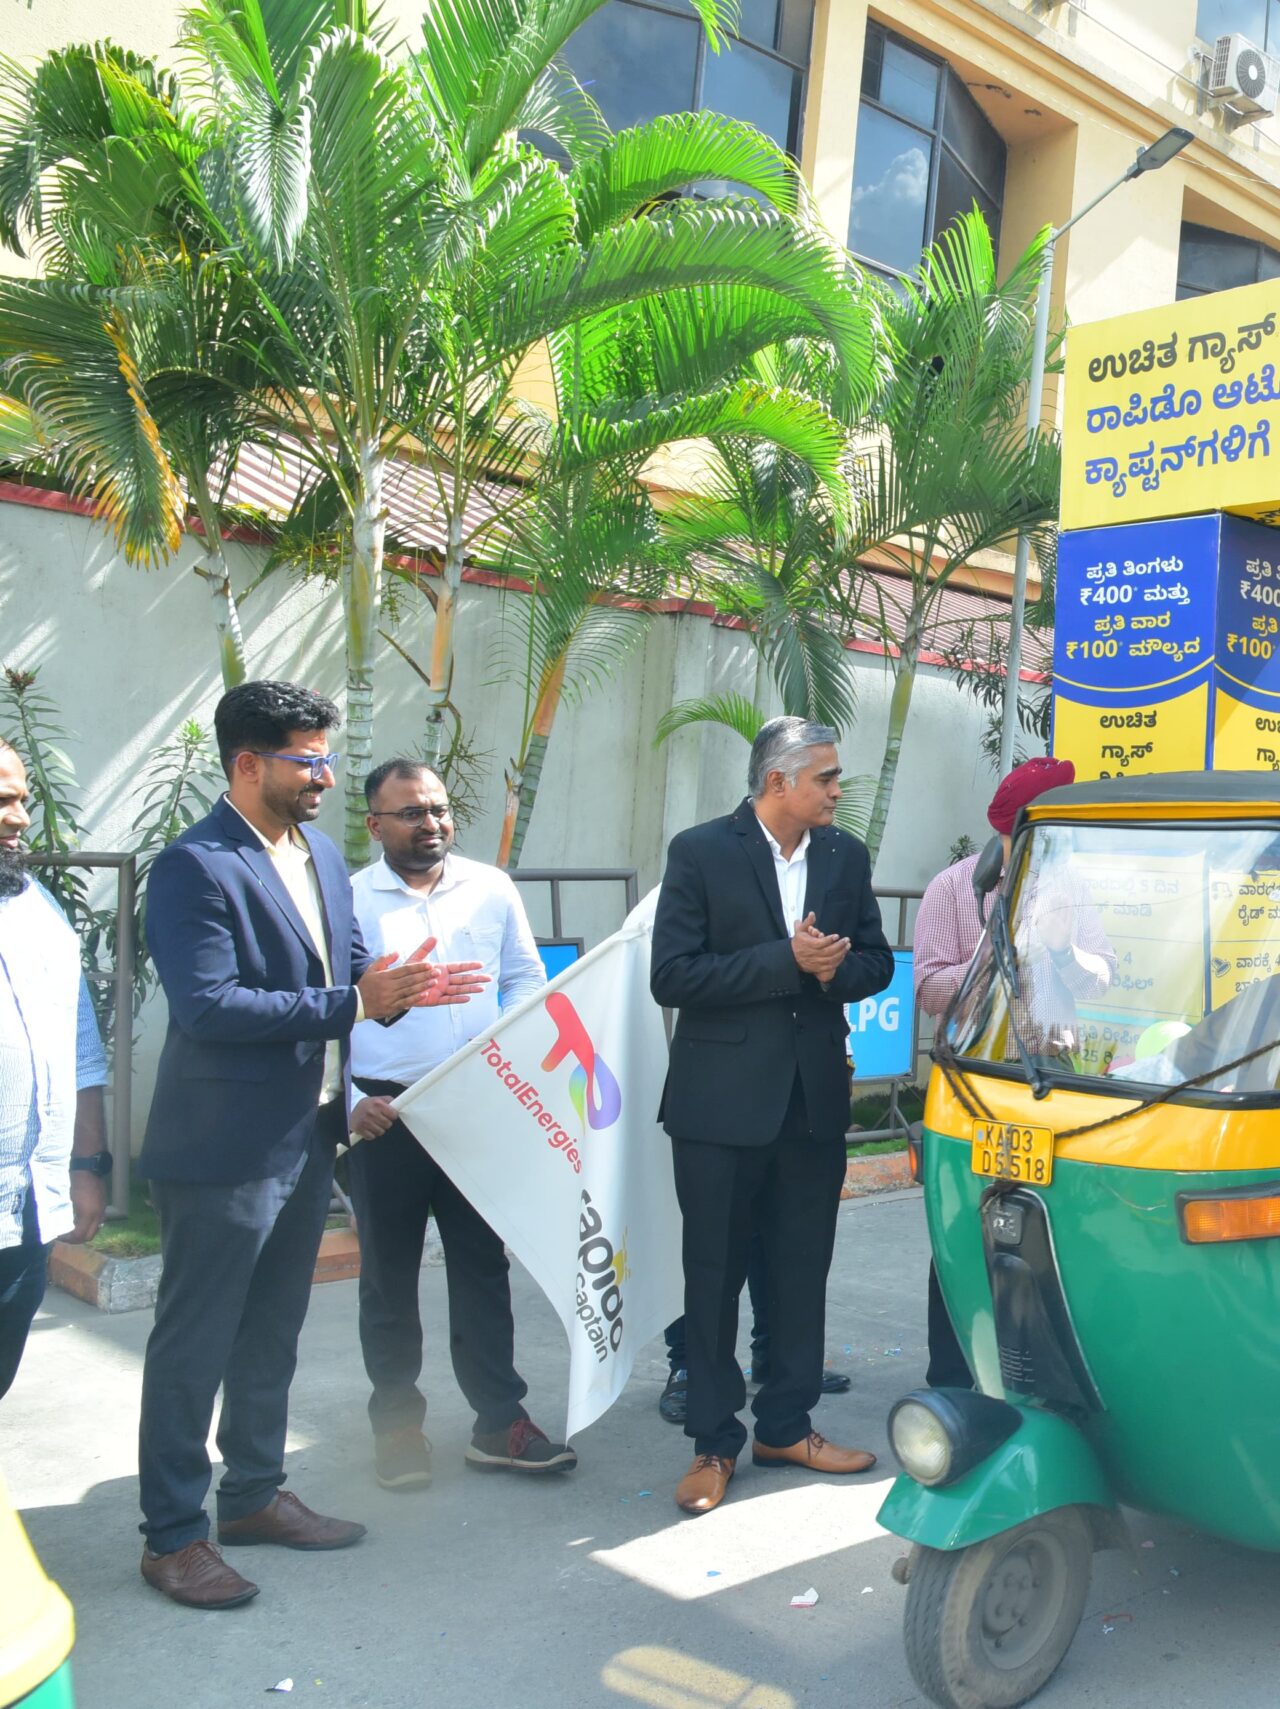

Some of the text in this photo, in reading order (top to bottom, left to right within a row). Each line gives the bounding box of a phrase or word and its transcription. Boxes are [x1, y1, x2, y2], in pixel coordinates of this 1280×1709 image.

[1088, 331, 1178, 383] ಉಚಿತ
[1188, 312, 1276, 374] ಗ್ಯಾಸ್
[1086, 383, 1202, 433] ರಾಪಿಡೊ
[1086, 555, 1184, 584] ಪ್ರತಿ ತಿಂಗಳು
[1245, 558, 1272, 580] ಪ್ರತಿ
[1143, 582, 1191, 605] ಮತ್ತು
[1094, 610, 1171, 637] ಪ್ರತಿ ವಾರ
[1252, 615, 1278, 637] ಪ್ರತಿ
[1100, 710, 1158, 729] ಉಚಿತ
[1101, 742, 1153, 767] ಗ್ಯಾಸ್
[480, 1038, 582, 1174] TotalEnergies
[578, 1189, 623, 1352] rapido
